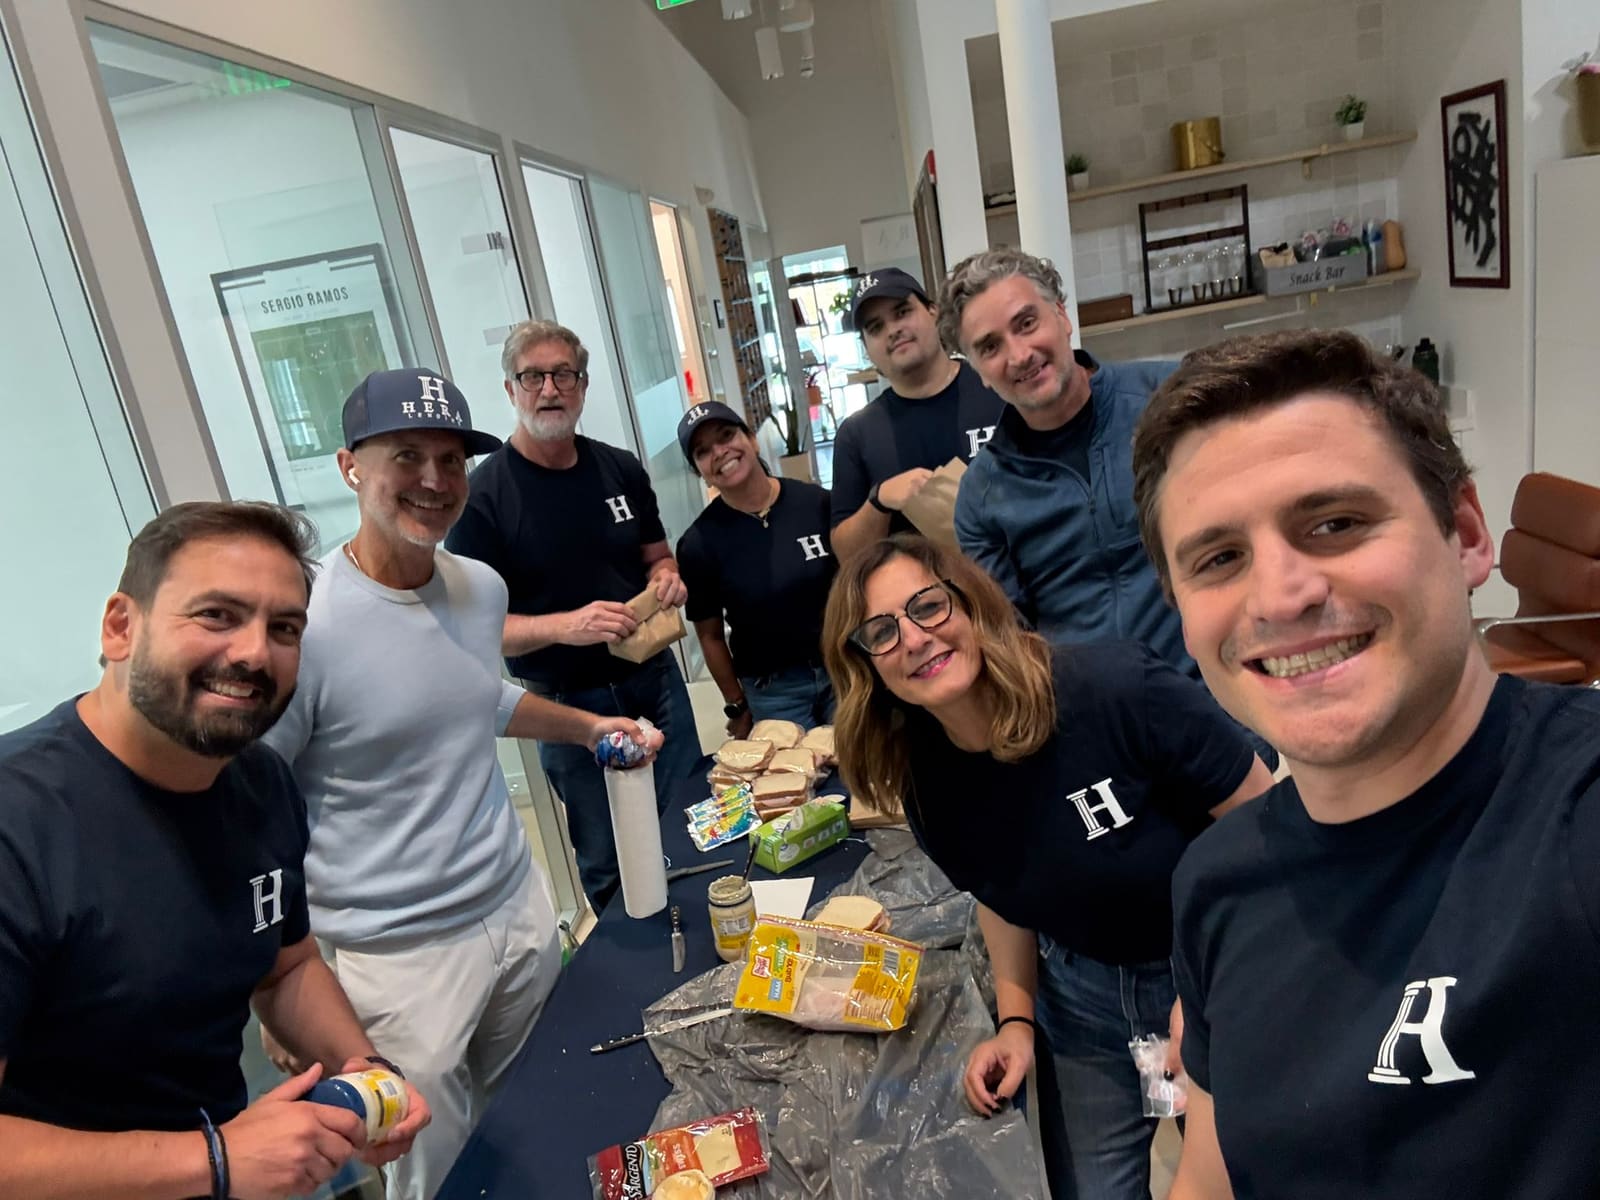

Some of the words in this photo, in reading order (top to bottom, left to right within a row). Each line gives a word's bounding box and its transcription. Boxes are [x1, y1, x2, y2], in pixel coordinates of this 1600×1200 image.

[1289, 266, 1321, 287] Snack
[1326, 265, 1346, 281] Bar
[260, 294, 304, 314] SERGIO
[306, 286, 349, 307] RAMOS
[417, 375, 449, 404] H
[401, 401, 463, 423] HERA
[605, 495, 634, 523] H
[797, 534, 829, 561] H
[1066, 777, 1134, 840] H
[249, 868, 284, 934] H
[1368, 976, 1476, 1085] H
[625, 1144, 643, 1199] SARGENTO
